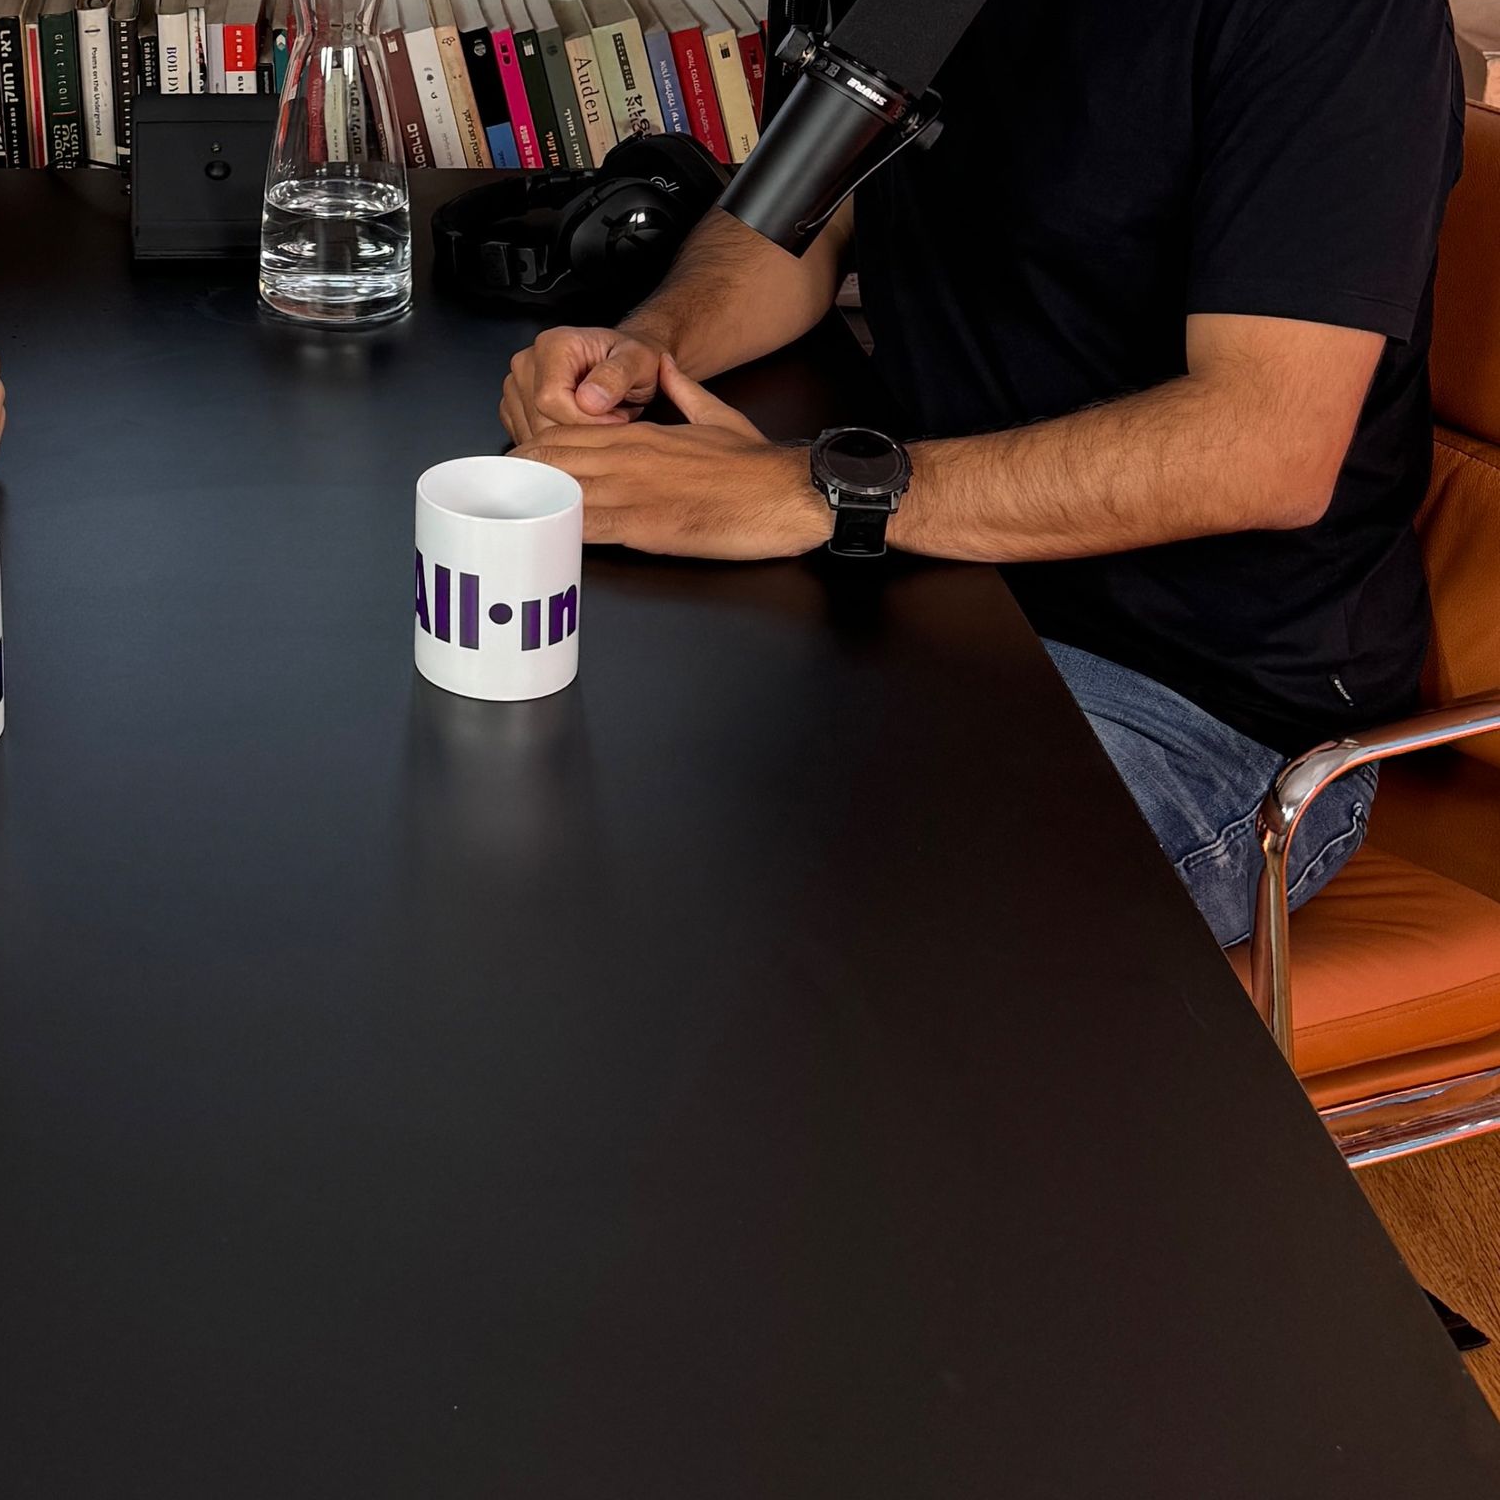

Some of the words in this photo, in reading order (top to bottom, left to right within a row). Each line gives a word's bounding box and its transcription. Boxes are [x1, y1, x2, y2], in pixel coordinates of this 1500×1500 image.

[0, 29, 12, 58] ראי
[91, 46, 99, 71] Poems
[143, 41, 152, 88] CHANDLER
[166, 46, 178, 73] BOB
[2, 62, 19, 103] רחוק
[168, 76, 179, 93] DY
[574, 57, 600, 125] Auden
[846, 77, 888, 107] SHURE
[94, 92, 102, 137] Underground
